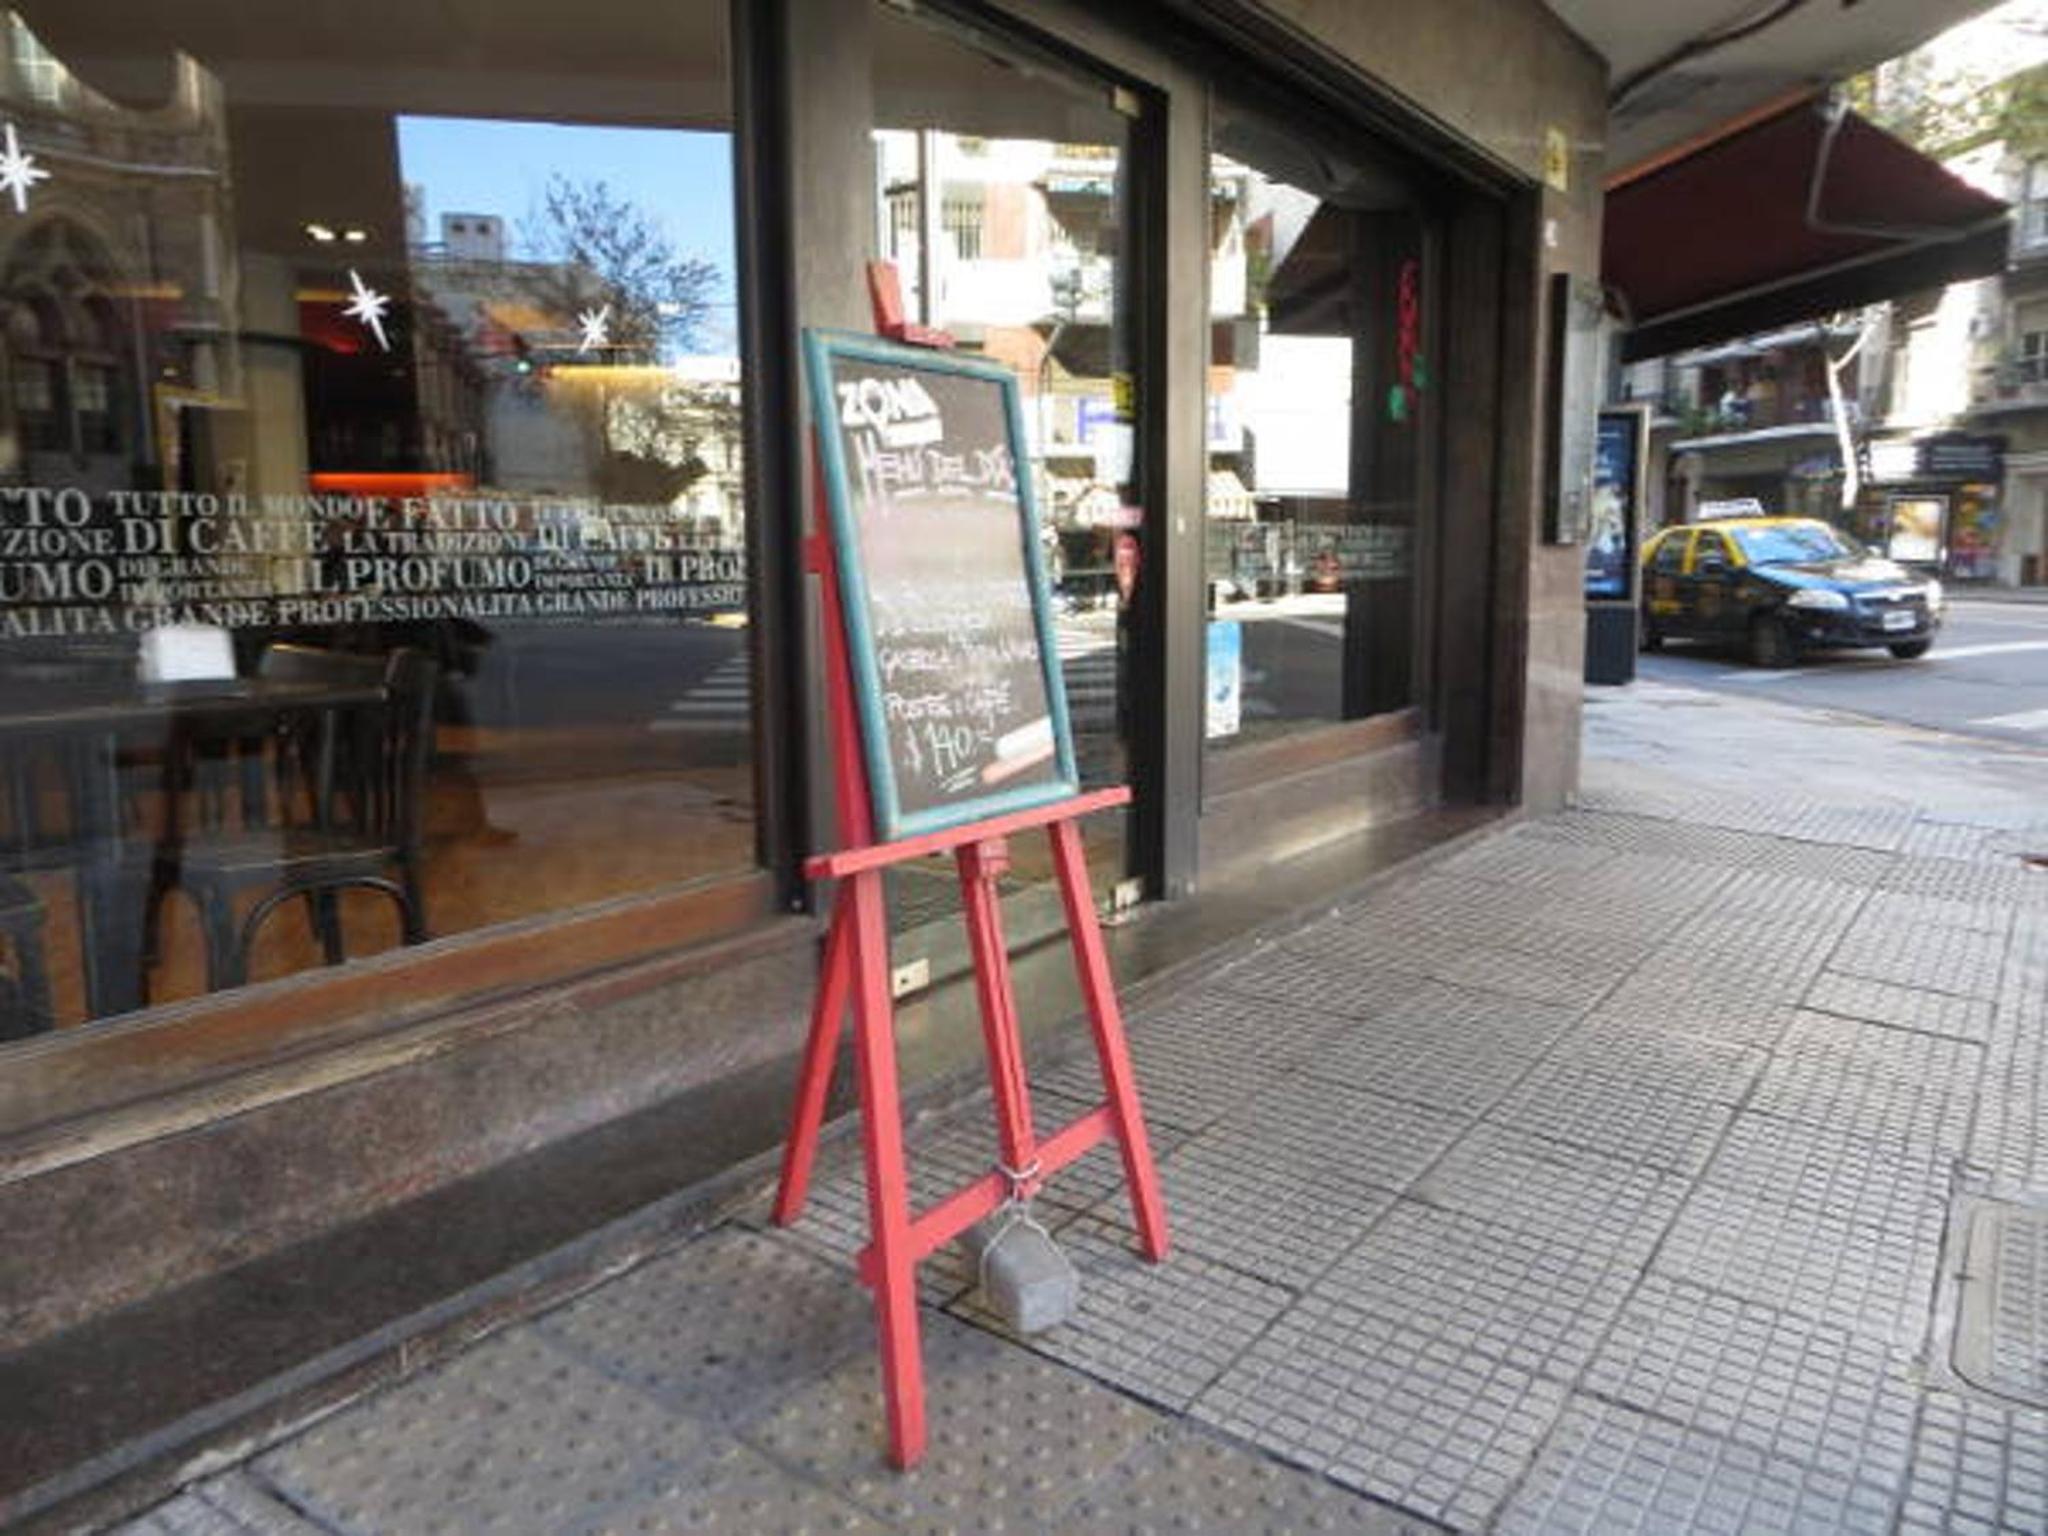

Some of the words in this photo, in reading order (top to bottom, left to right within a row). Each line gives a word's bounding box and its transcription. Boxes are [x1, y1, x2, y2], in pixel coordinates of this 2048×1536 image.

[108, 490, 219, 518] TUTTO
[403, 497, 518, 530] FATTO
[123, 519, 182, 555] DI
[293, 558, 340, 593] IL
[346, 556, 532, 592] PROFUMO
[125, 600, 271, 632] GRANDE
